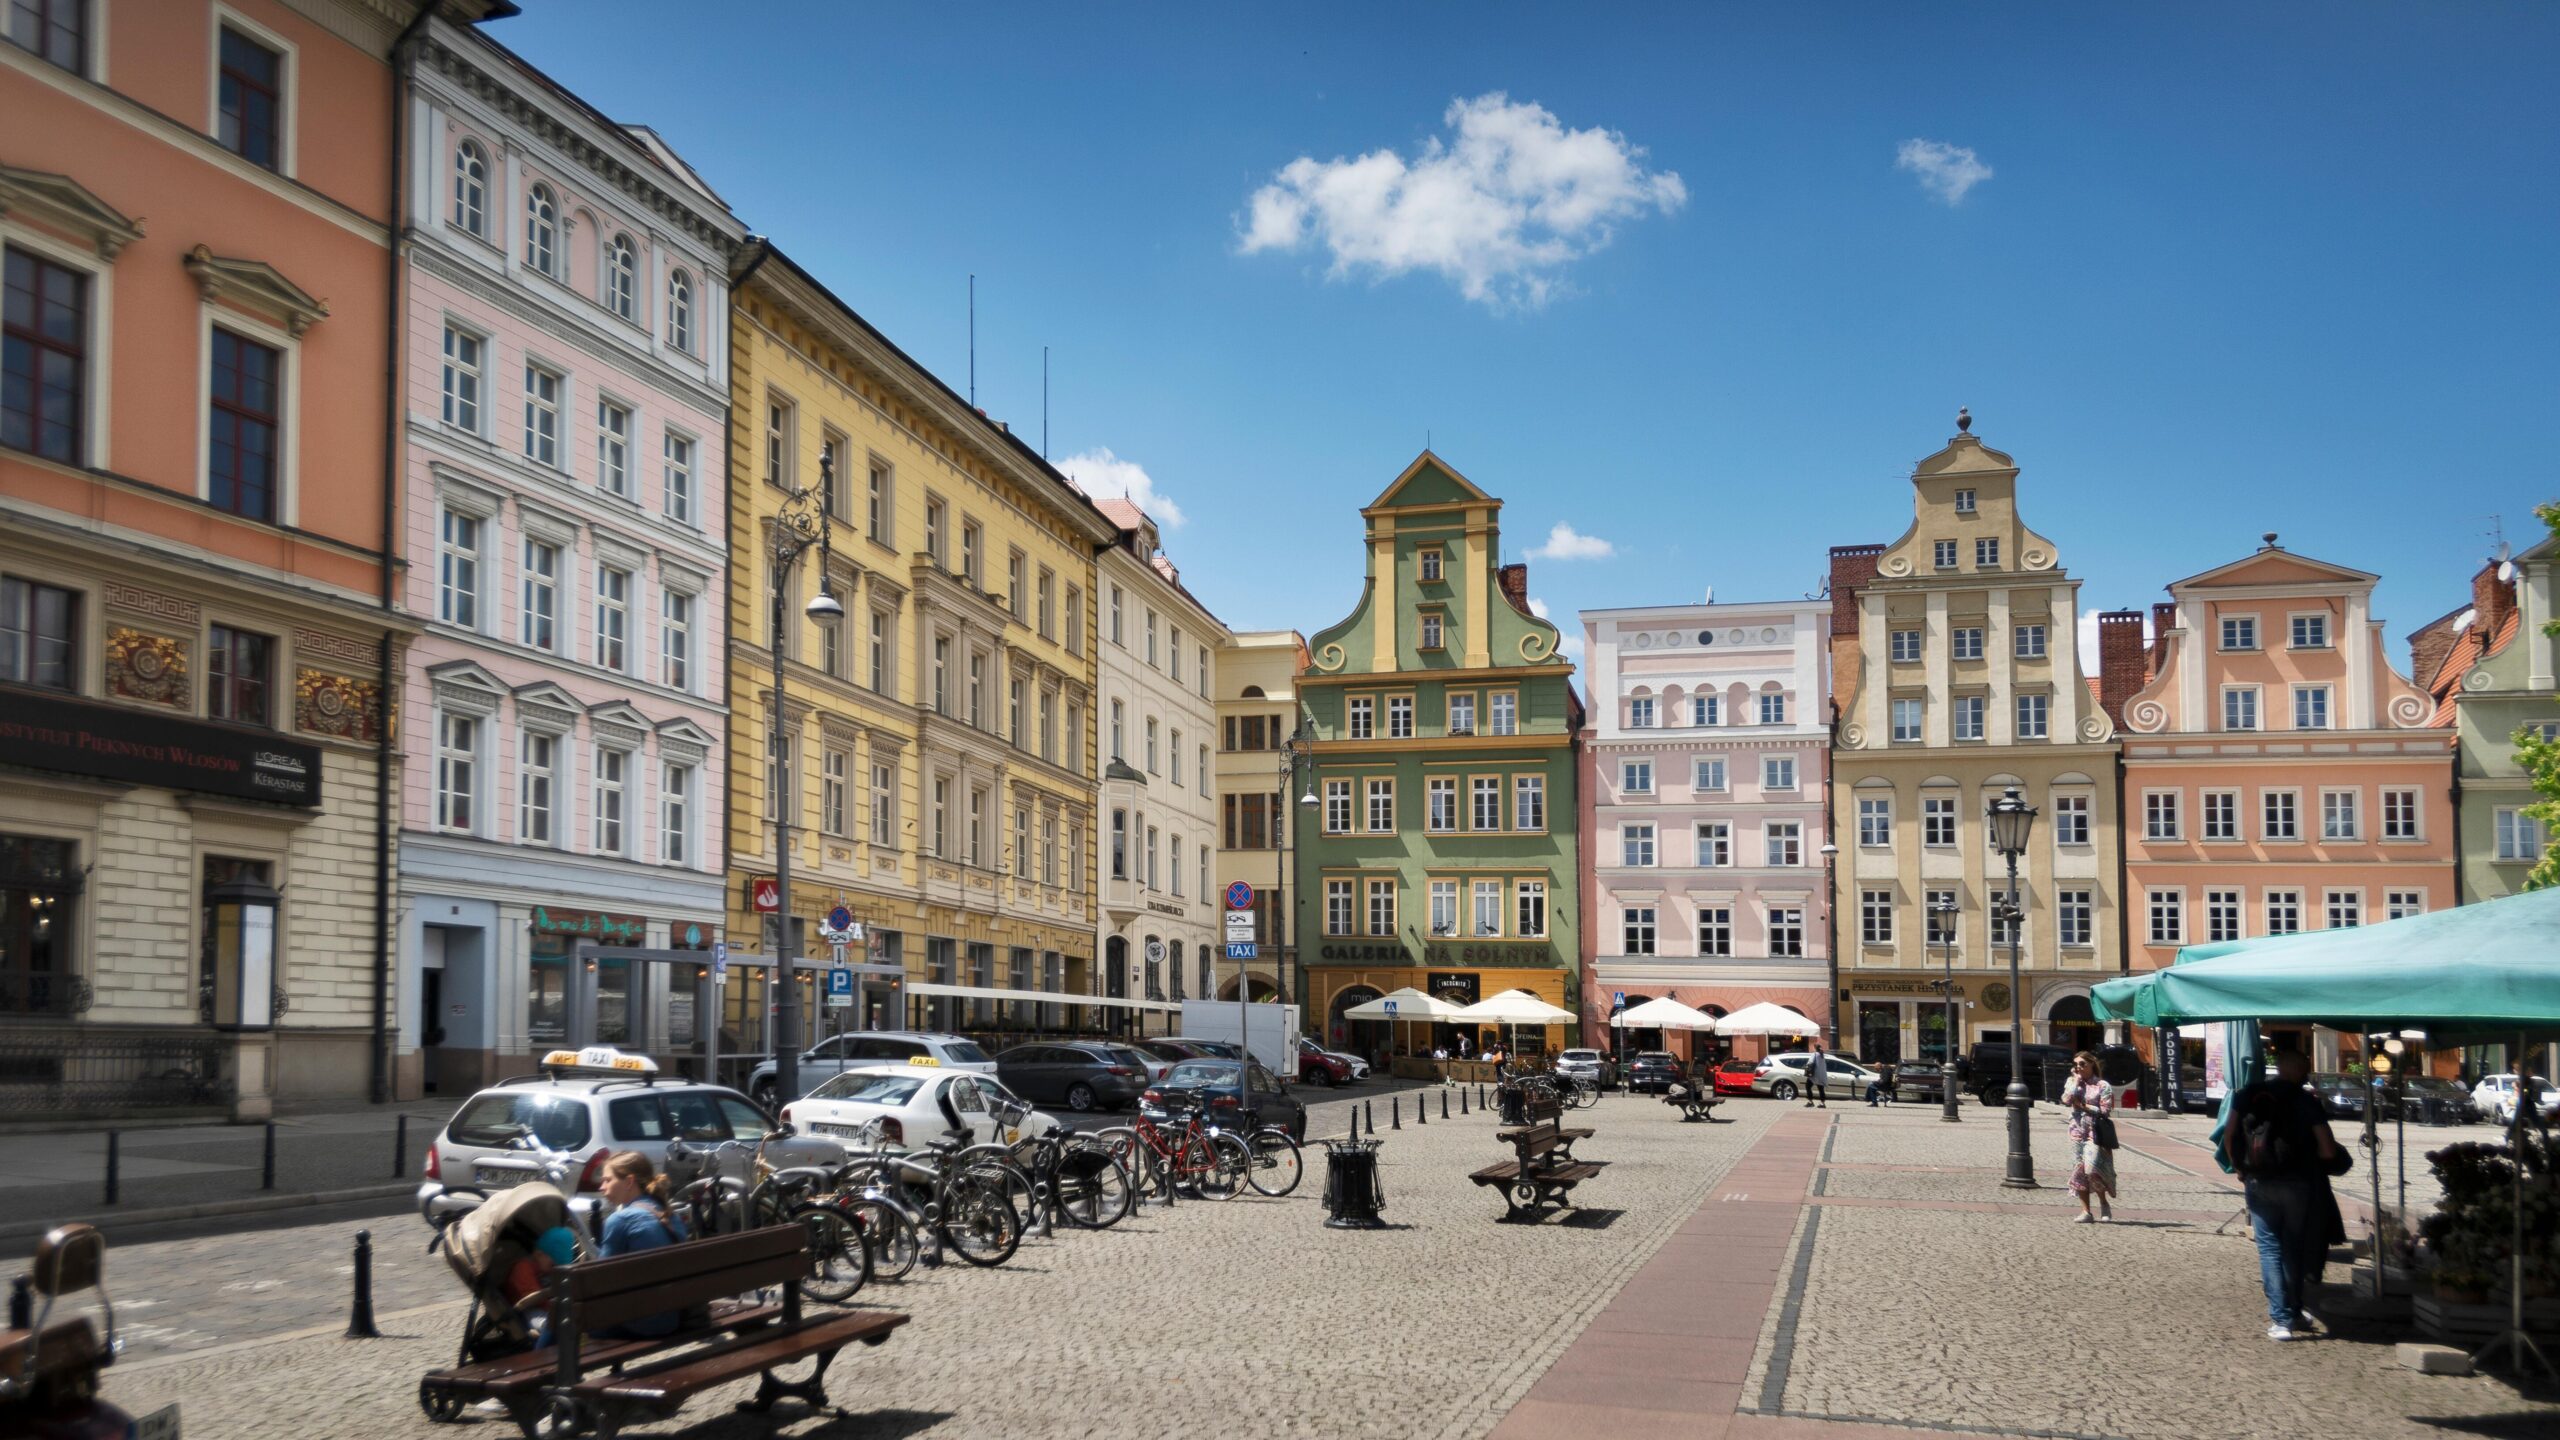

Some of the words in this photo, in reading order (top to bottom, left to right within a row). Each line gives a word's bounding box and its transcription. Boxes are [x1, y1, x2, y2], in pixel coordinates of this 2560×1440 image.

[1229, 945, 1255, 956] TAXI
[1321, 945, 1412, 960] GALERIA
[1424, 946, 1451, 962] NA
[1463, 945, 1550, 963] SOLNYM
[833, 972, 847, 991] P
[1852, 983, 1914, 993] PRZYSTANEK
[1918, 984, 1965, 994] HISTOIA
[587, 1051, 609, 1065] TAXI
[912, 1057, 935, 1066] TAXI
[2166, 1031, 2178, 1108] PODZIEMIA
